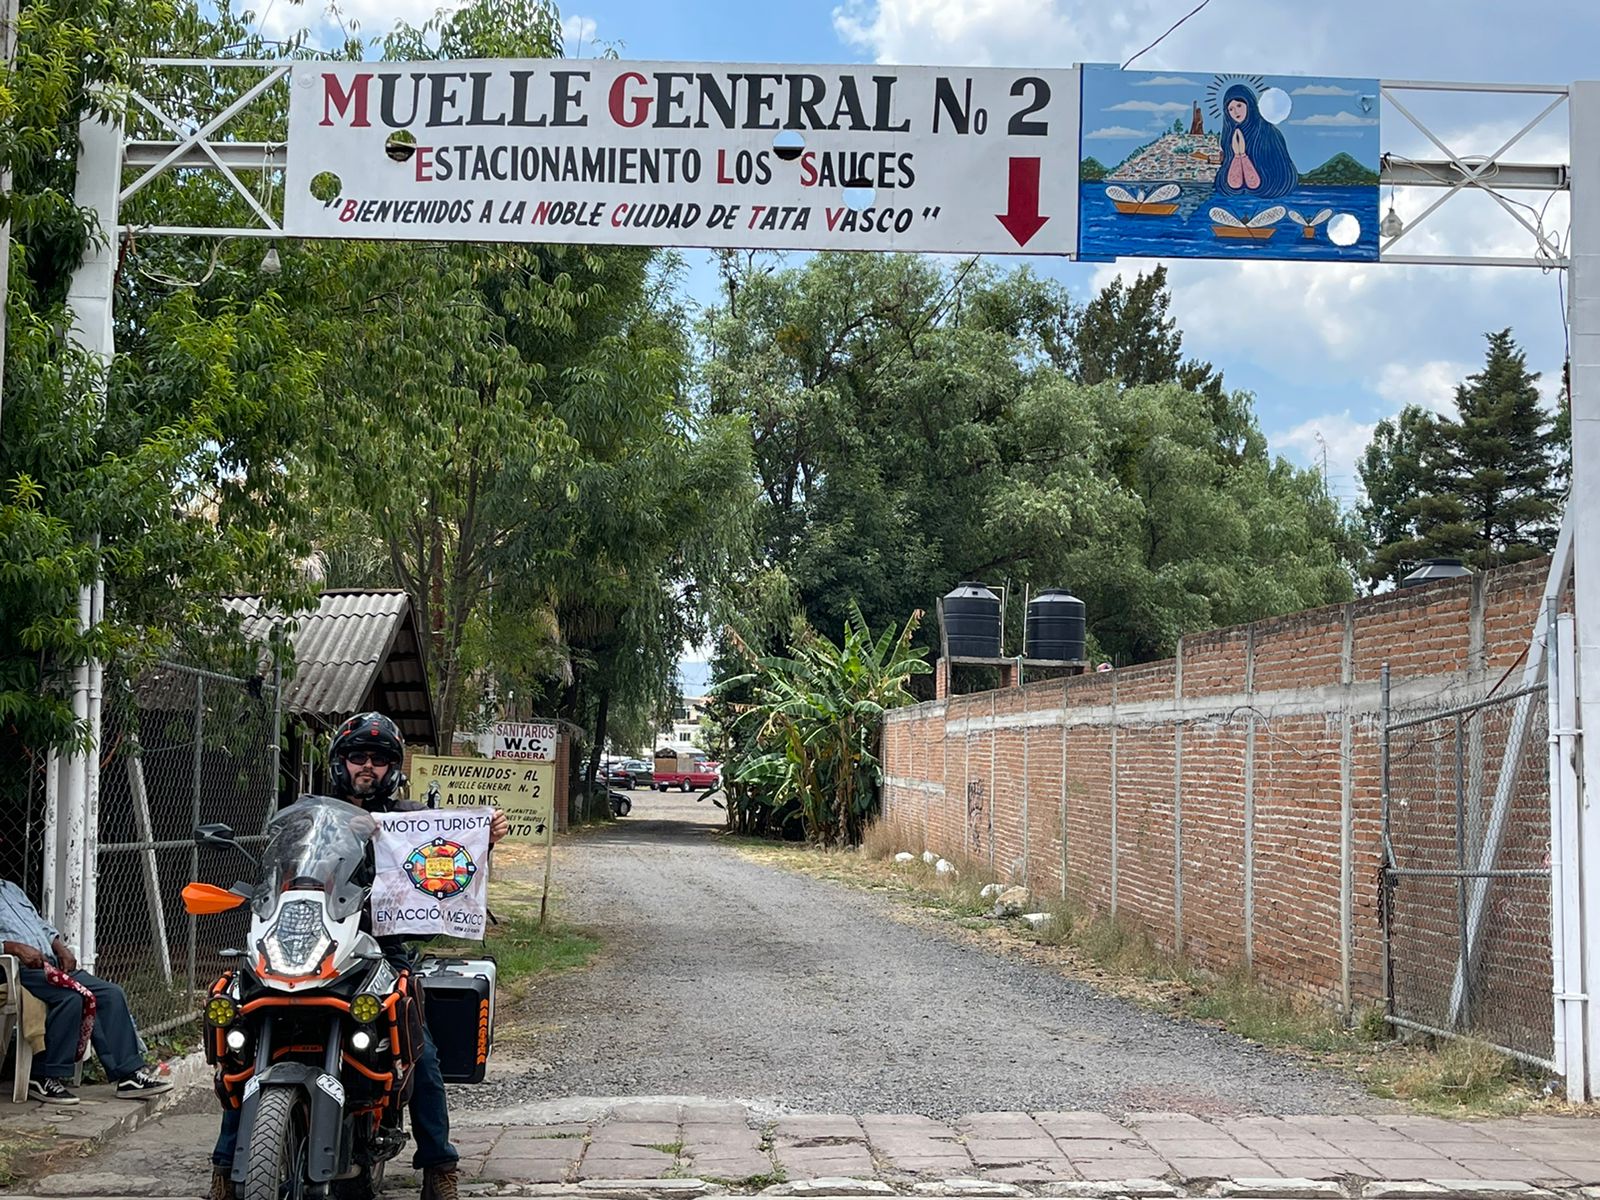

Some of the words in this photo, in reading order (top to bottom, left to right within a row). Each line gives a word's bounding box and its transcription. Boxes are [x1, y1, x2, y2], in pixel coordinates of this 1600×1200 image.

[318, 70, 591, 128] MUELLE
[608, 71, 911, 132] GENERAL
[1007, 76, 1052, 136] 2
[415, 145, 702, 184] ESTACIONAMIENTO
[717, 148, 772, 185] LOS
[800, 151, 916, 188] SAUCES
[478, 199, 493, 224] A
[499, 200, 525, 225] LA
[531, 200, 607, 227] NOBLE
[611, 202, 702, 230] CIUDAD
[706, 204, 741, 230] DE
[746, 205, 811, 231] TATA
[496, 723, 555, 739] SANITARIOS
[504, 737, 548, 752] W.C.
[495, 749, 546, 760] REGADERA
[524, 770, 539, 782] AL
[447, 780, 475, 790] MUELLE
[477, 781, 512, 792] GENERAL
[532, 785, 541, 798] 2
[446, 793, 455, 805] A
[458, 793, 476, 806] 100
[382, 820, 430, 833] MOTO
[434, 816, 491, 832] TURISTA
[376, 910, 393, 923] EN
[447, 908, 484, 926] MÉXICO
